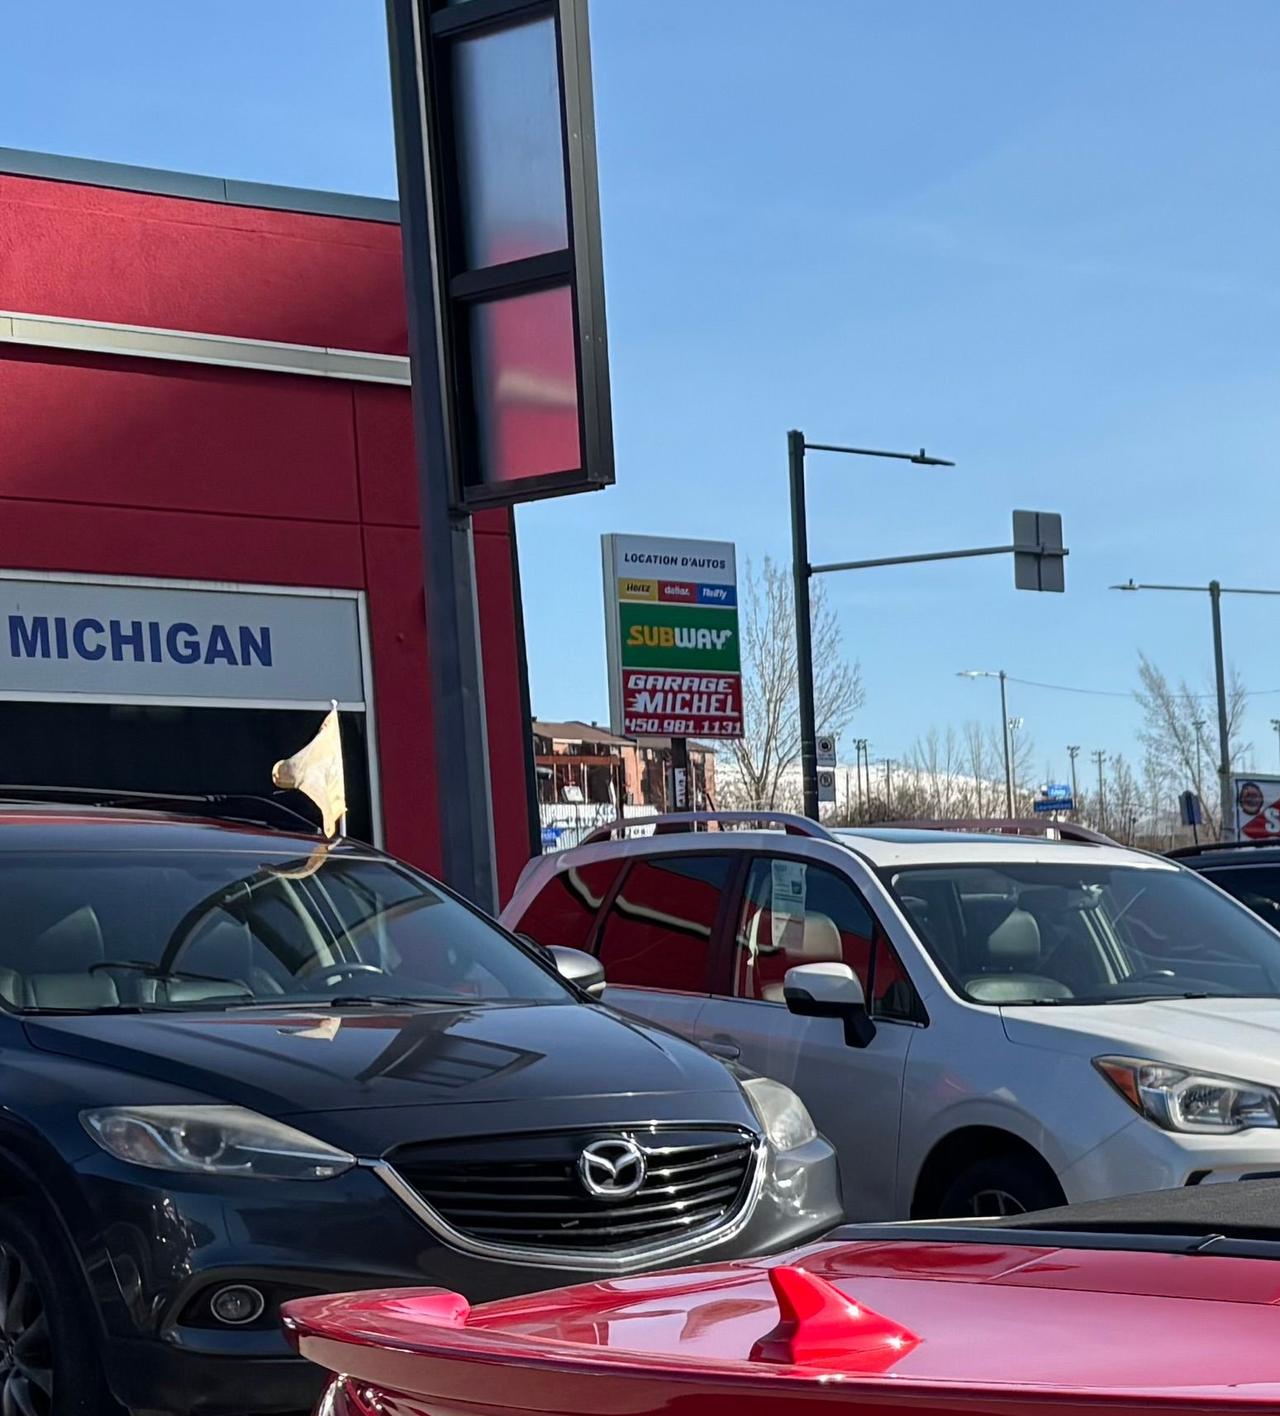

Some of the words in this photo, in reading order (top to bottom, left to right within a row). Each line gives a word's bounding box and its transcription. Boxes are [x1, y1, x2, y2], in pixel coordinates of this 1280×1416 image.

[624, 552, 678, 566] LOCATION
[681, 557, 726, 569] D'AUTOS
[8, 613, 274, 668] MICHIGAN
[627, 624, 733, 651] SUBWAY
[628, 674, 736, 694] GARAGE
[636, 692, 740, 717] MICHEL
[625, 718, 743, 736] 450.981.1131
